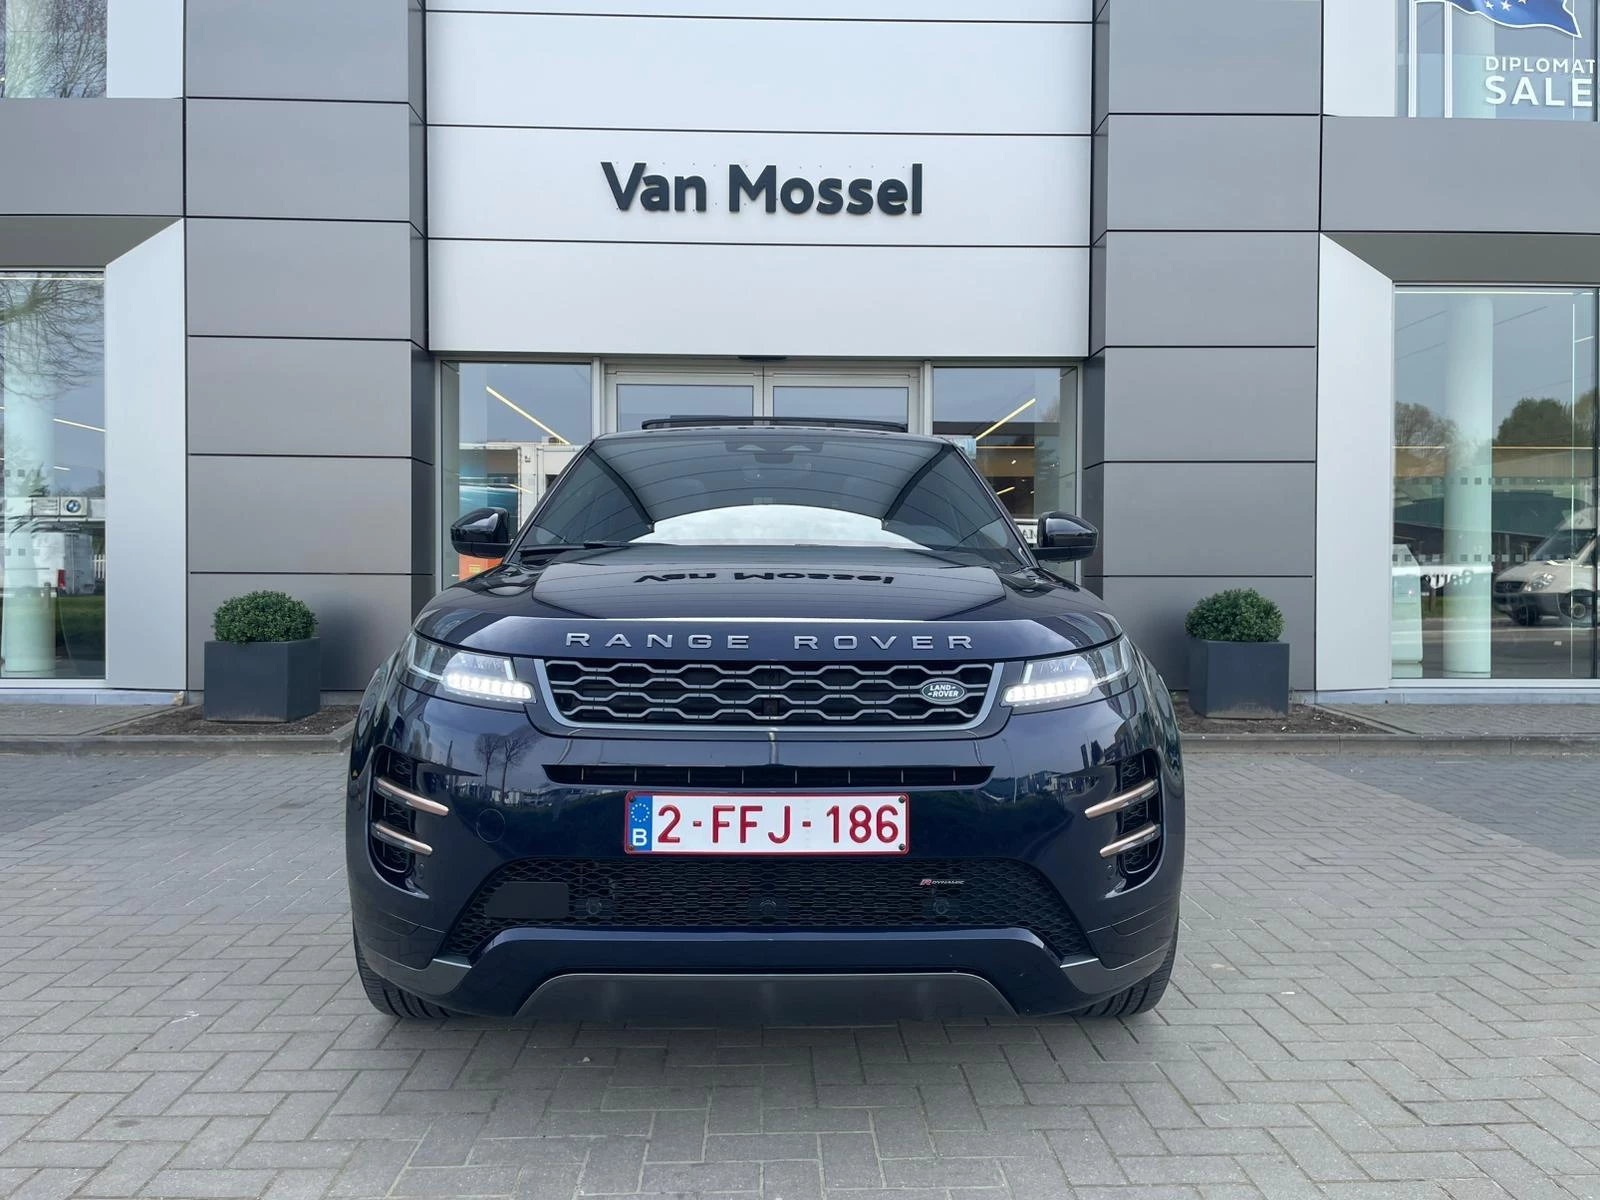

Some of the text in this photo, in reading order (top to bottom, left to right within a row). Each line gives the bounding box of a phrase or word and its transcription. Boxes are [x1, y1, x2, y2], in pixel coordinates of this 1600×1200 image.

[1485, 75, 1593, 107] SALE
[600, 161, 923, 216] Van Mossel
[565, 632, 973, 650] RANGE ROVER
[632, 828, 647, 847] B
